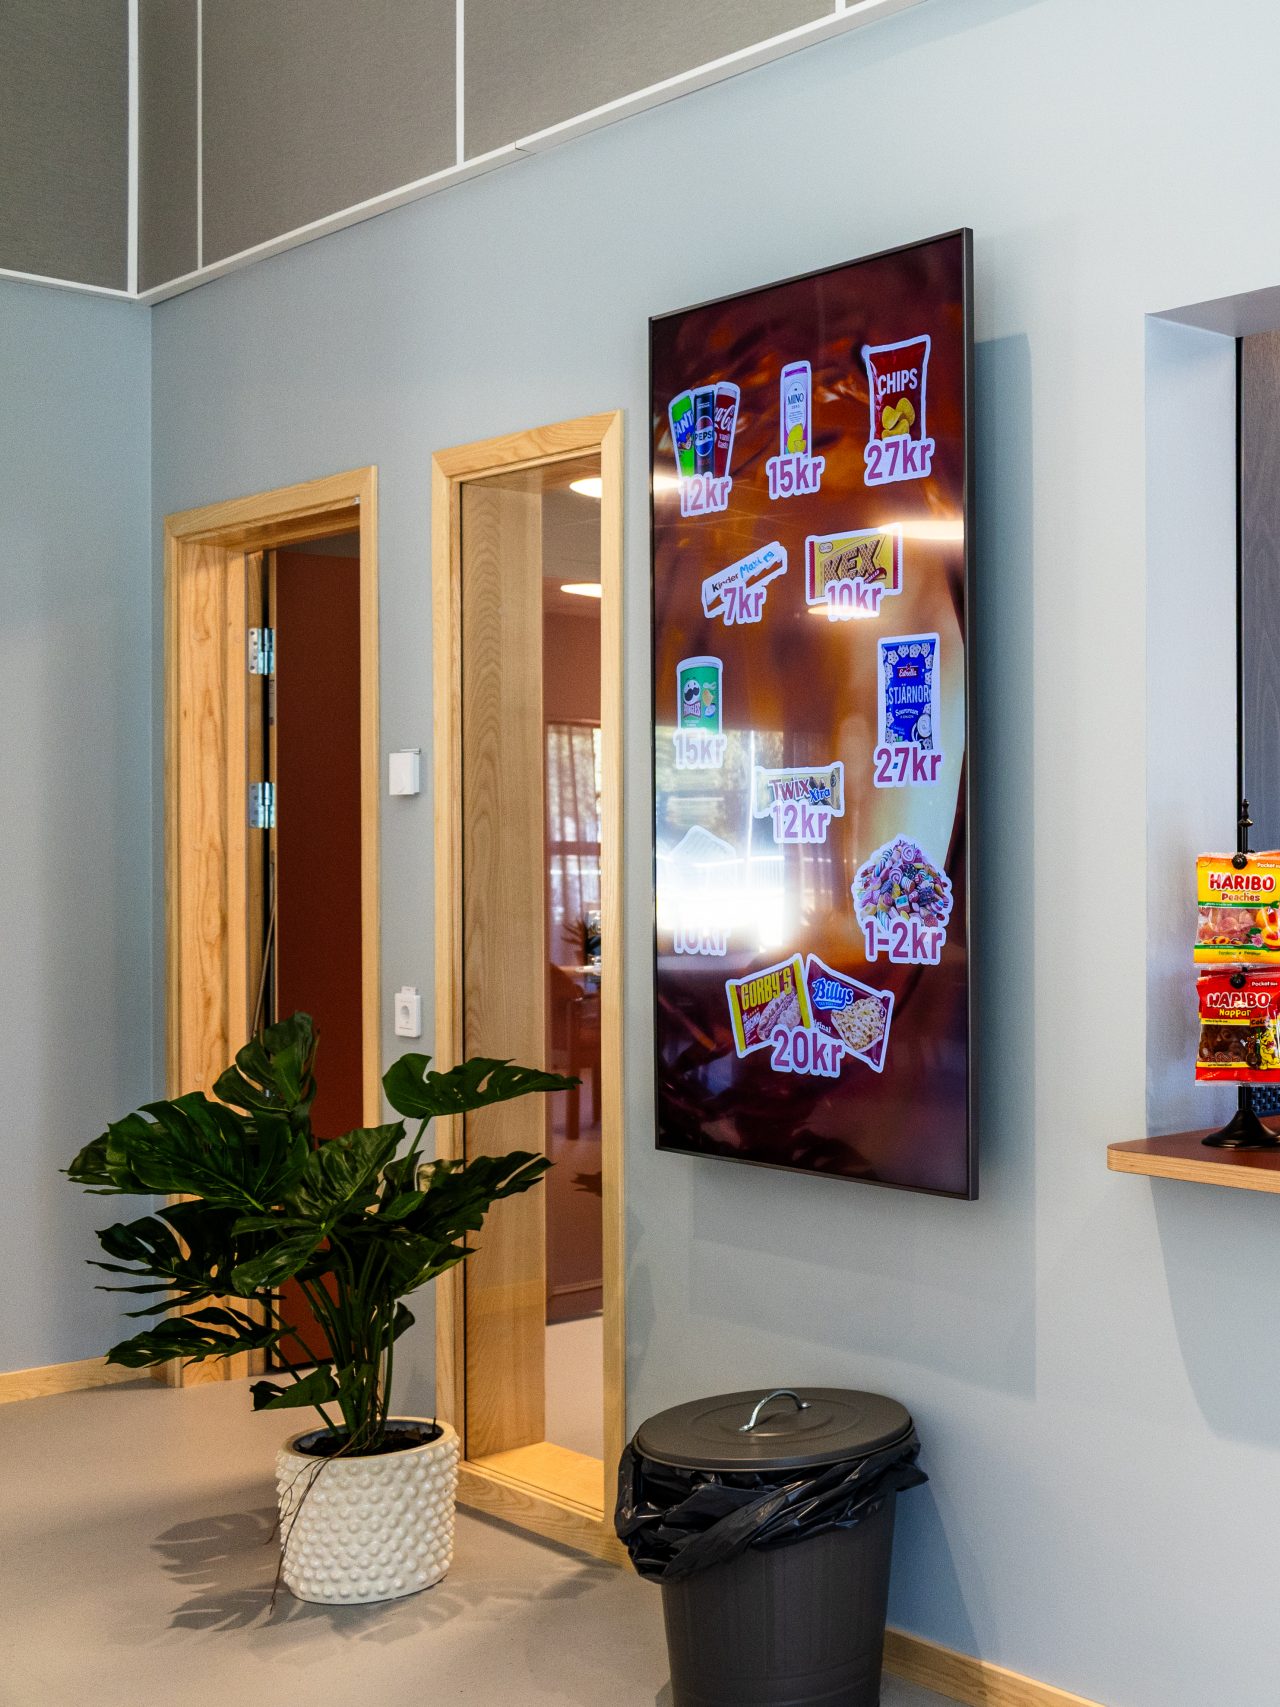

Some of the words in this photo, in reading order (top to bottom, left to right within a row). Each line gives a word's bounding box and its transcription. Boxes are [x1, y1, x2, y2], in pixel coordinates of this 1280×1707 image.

[878, 368, 918, 396] CHIPS
[695, 430, 713, 441] PEPS
[768, 457, 822, 494] 15kr
[867, 439, 932, 480] 27kr
[683, 477, 729, 513] 12kr
[823, 540, 881, 583] KEX
[723, 586, 764, 620] 7kr
[827, 582, 882, 614] 10kr
[888, 683, 930, 705] STJÄRNOR
[675, 733, 725, 766] 15kr
[876, 746, 942, 783] 27kr
[808, 788, 831, 802] Xtra
[772, 804, 828, 838] 12kr
[1208, 872, 1276, 892] HARIBO
[1221, 892, 1261, 902] Peaches
[864, 920, 943, 960] 1-2kr
[813, 978, 853, 1003] Billys
[1206, 991, 1272, 1009] HARIBO
[1218, 1008, 1252, 1018] Nappar
[773, 1029, 842, 1073] 20kr
